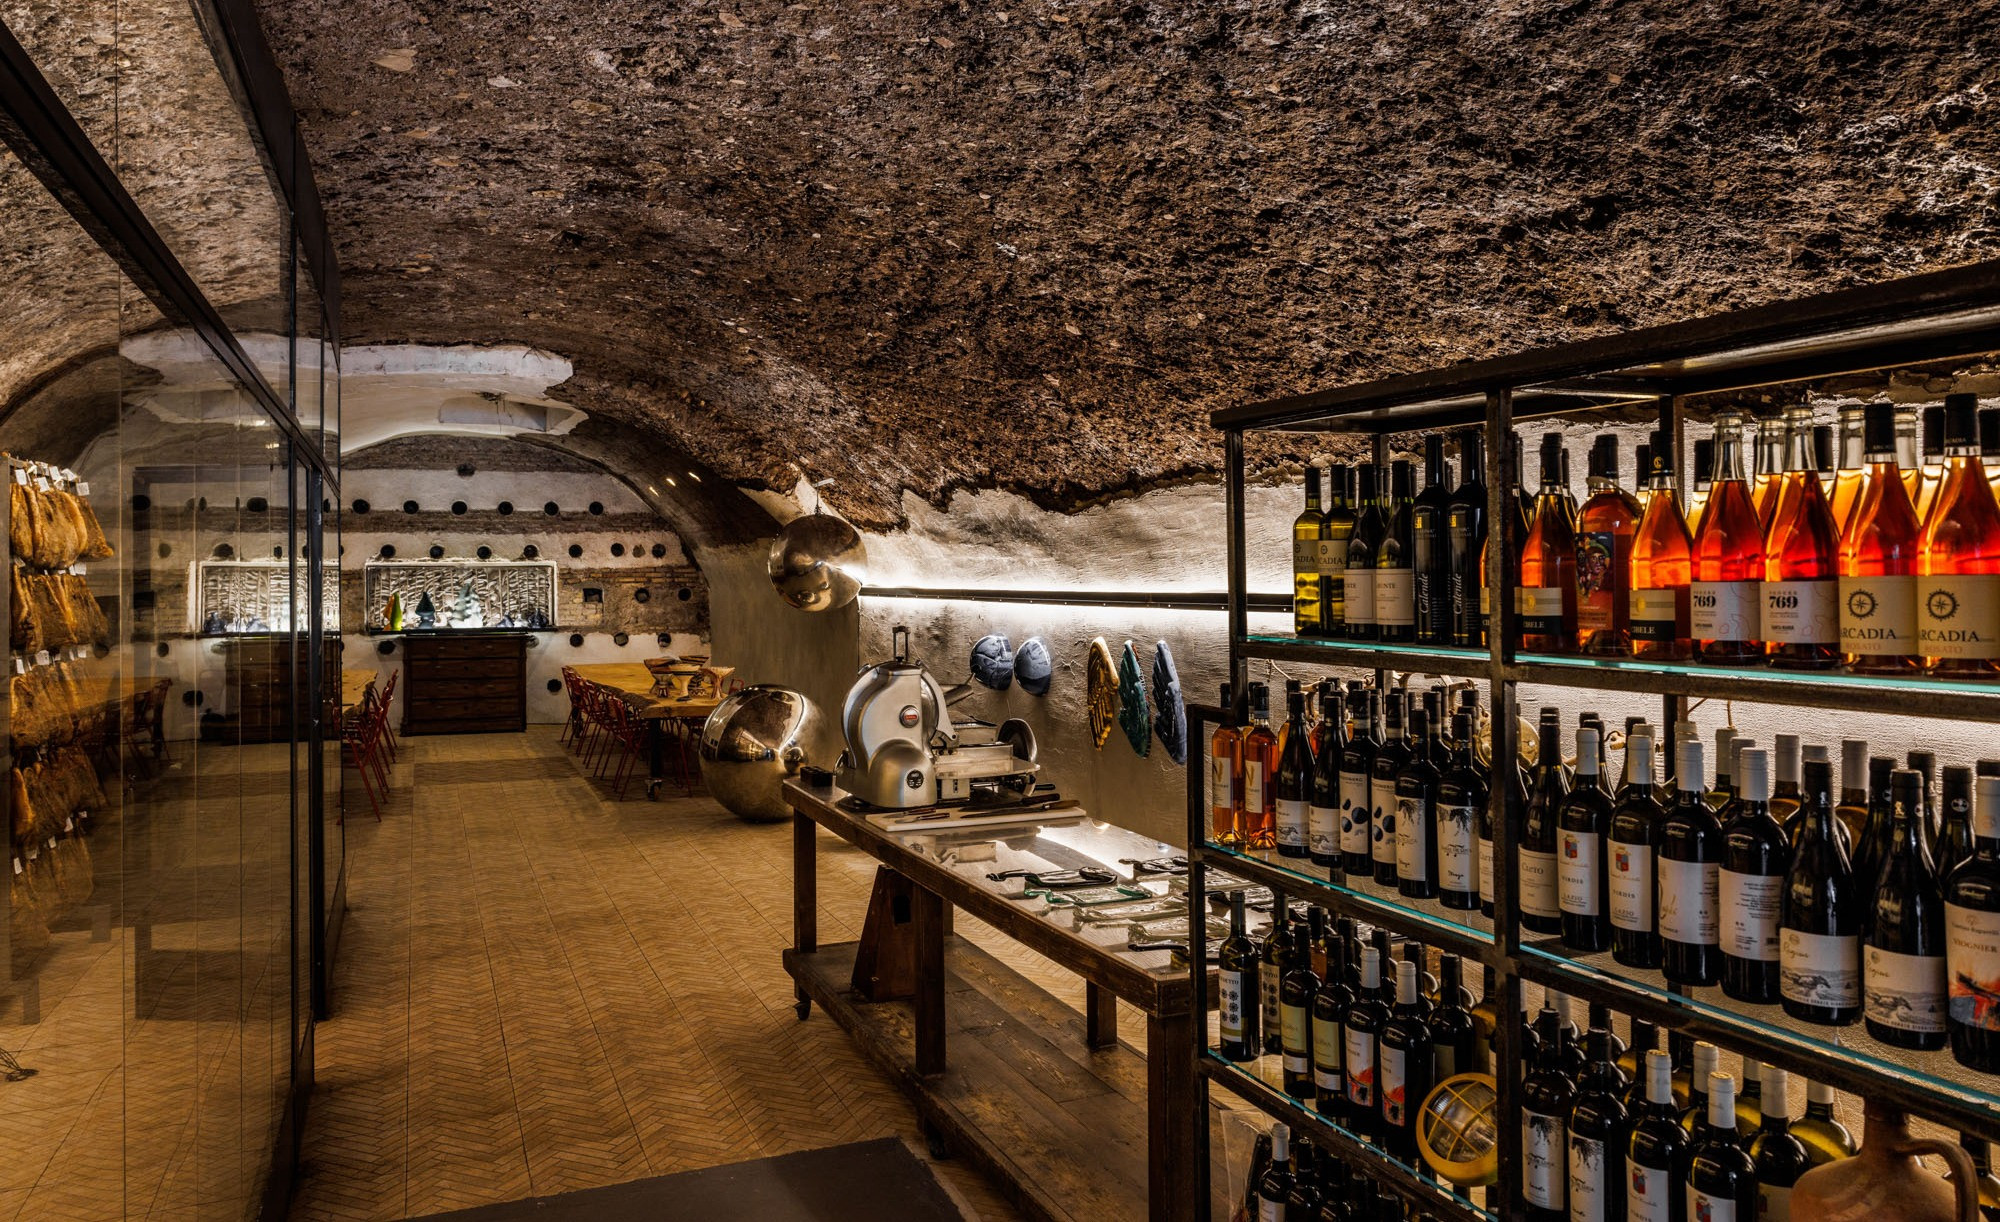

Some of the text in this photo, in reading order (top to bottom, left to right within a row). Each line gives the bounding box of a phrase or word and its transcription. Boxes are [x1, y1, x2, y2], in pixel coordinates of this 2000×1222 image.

[1418, 573, 1429, 613] Calende
[1452, 573, 1462, 615] Calende
[1693, 595, 1716, 608] 769
[1769, 595, 1798, 609] 769
[1953, 937, 1998, 953] VIOGNIER
